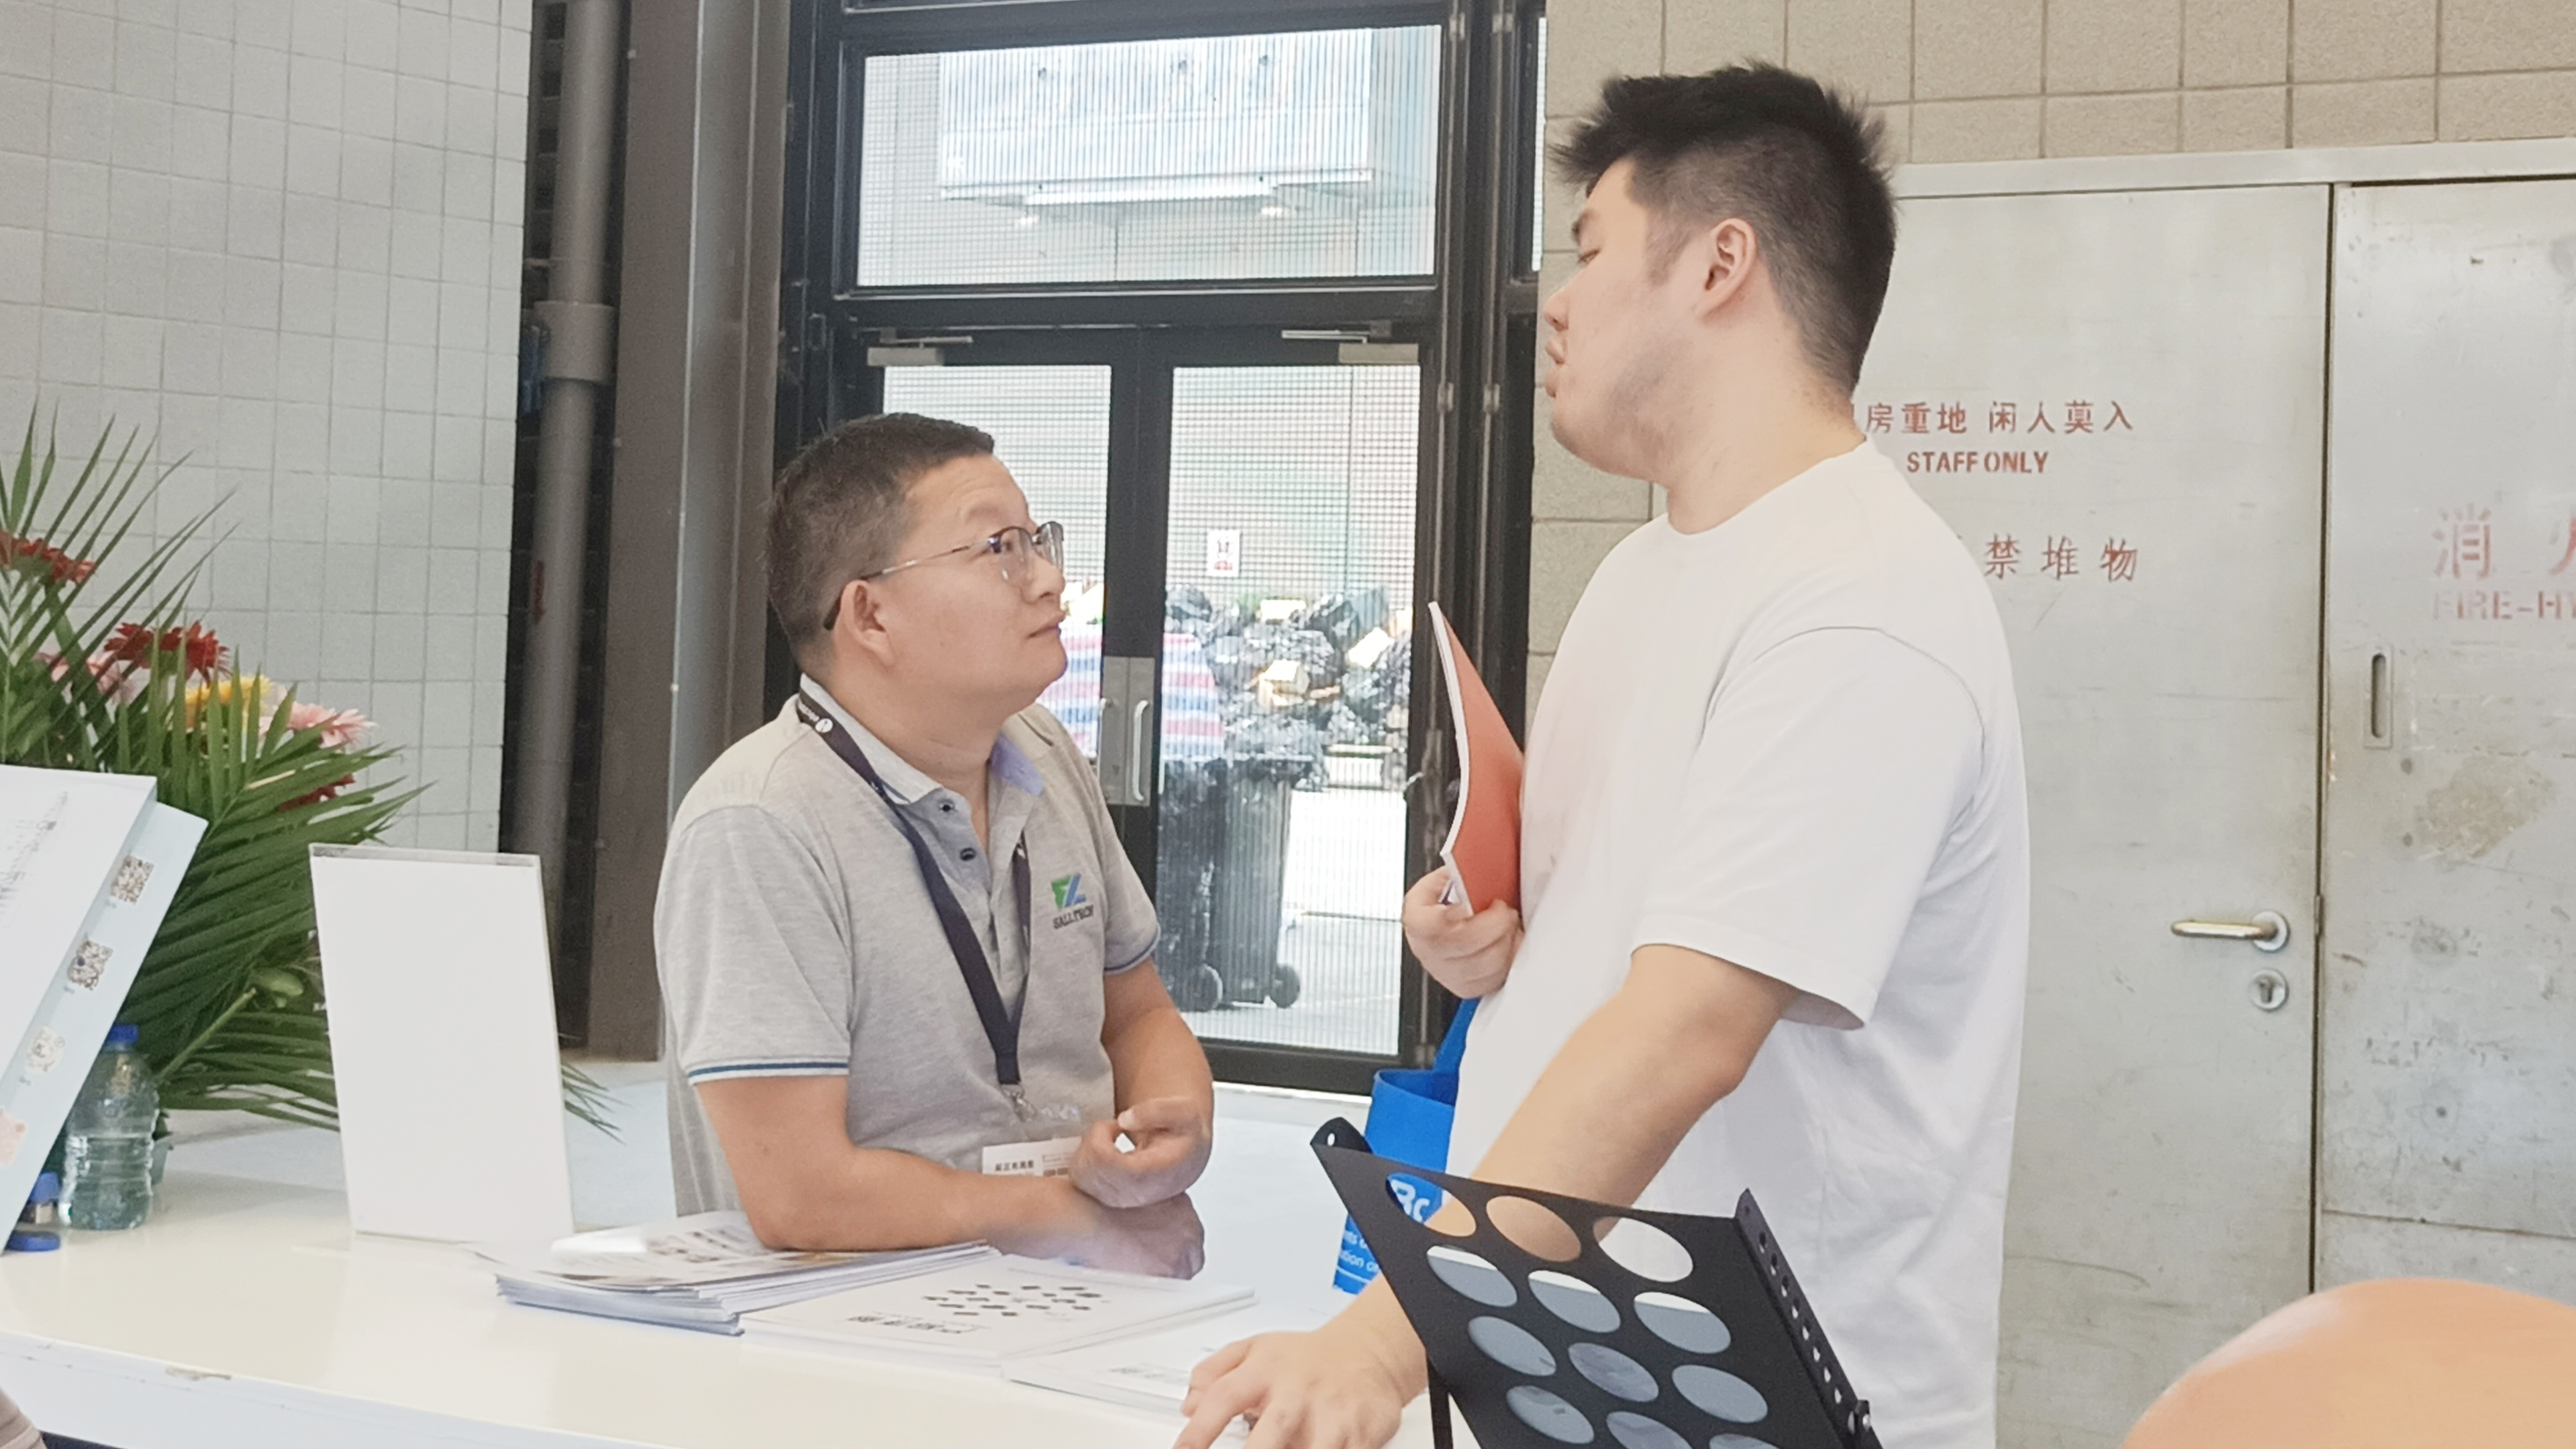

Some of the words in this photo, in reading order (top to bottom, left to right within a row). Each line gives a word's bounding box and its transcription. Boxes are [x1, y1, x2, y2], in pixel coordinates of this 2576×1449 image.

[1865, 401, 1967, 435] 房重地
[1989, 400, 2133, 435] 闲人莫入
[1906, 451, 1978, 473] STAFF
[1983, 451, 2049, 474] ONLY
[1983, 531, 2138, 583] 禁堆物
[2432, 589, 2576, 621] FIRE-H
